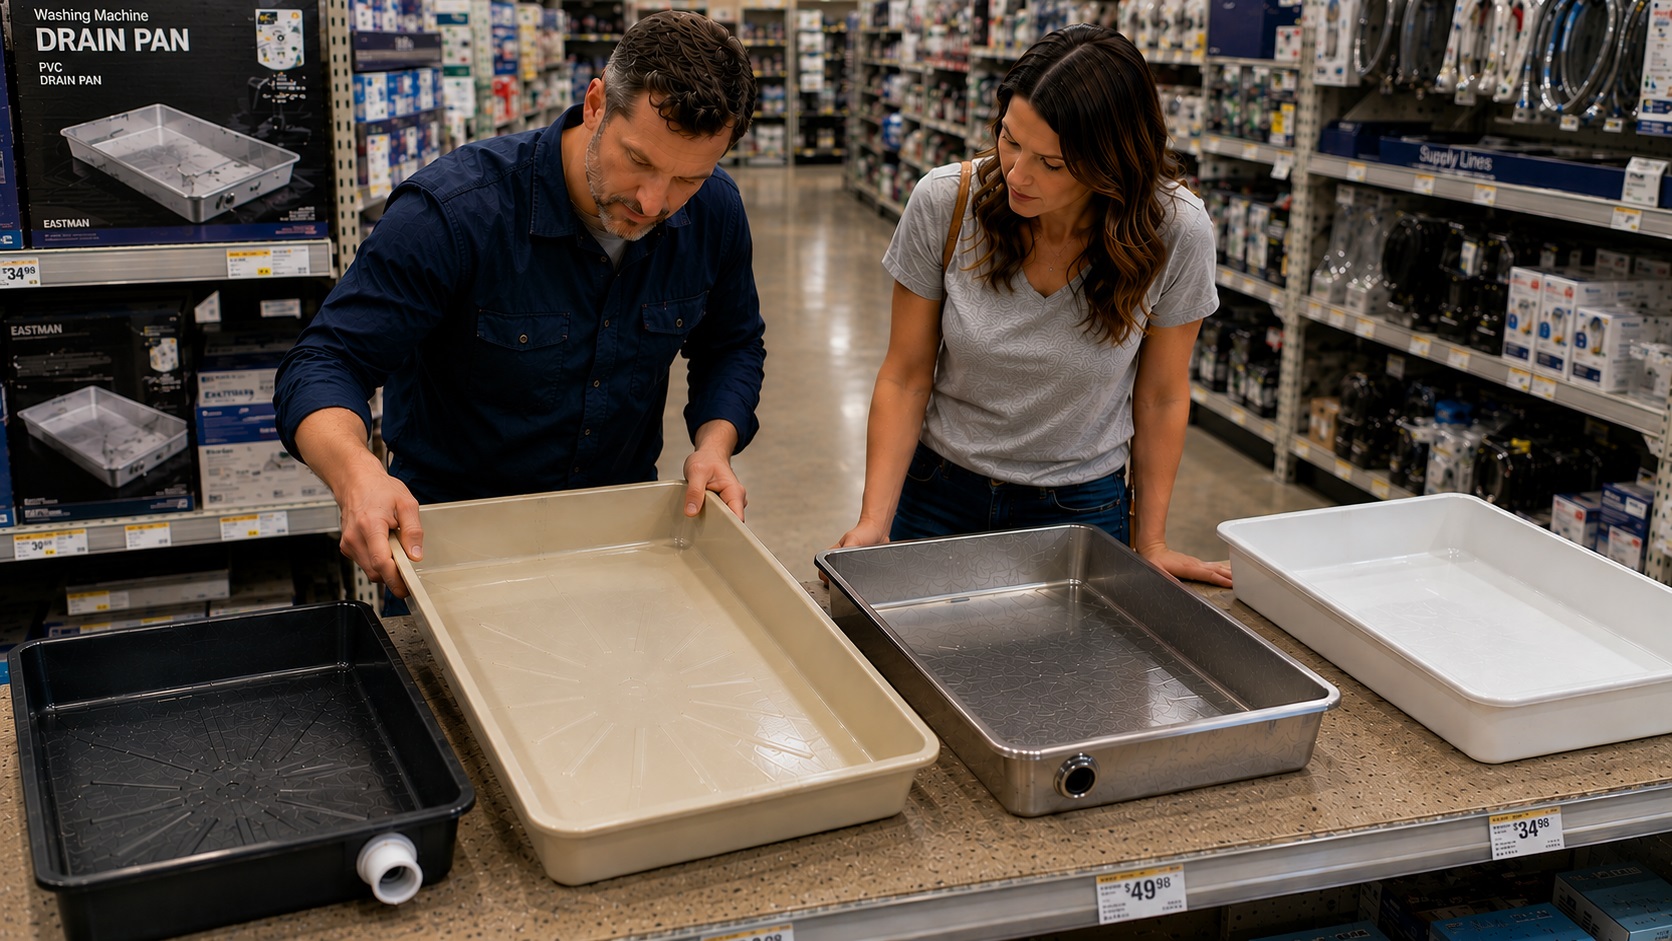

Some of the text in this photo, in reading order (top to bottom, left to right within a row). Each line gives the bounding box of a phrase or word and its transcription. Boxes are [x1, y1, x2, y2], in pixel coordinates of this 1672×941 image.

[34, 8, 149, 24] Washing Machine
[36, 27, 190, 51] DRAIN PAN
[39, 62, 63, 73] PVC
[40, 75, 102, 85] DRAIN PAN
[1419, 145, 1493, 171] Supply Lines
[43, 218, 90, 228] EASTMAN
[10, 323, 63, 336] EASTMAN
